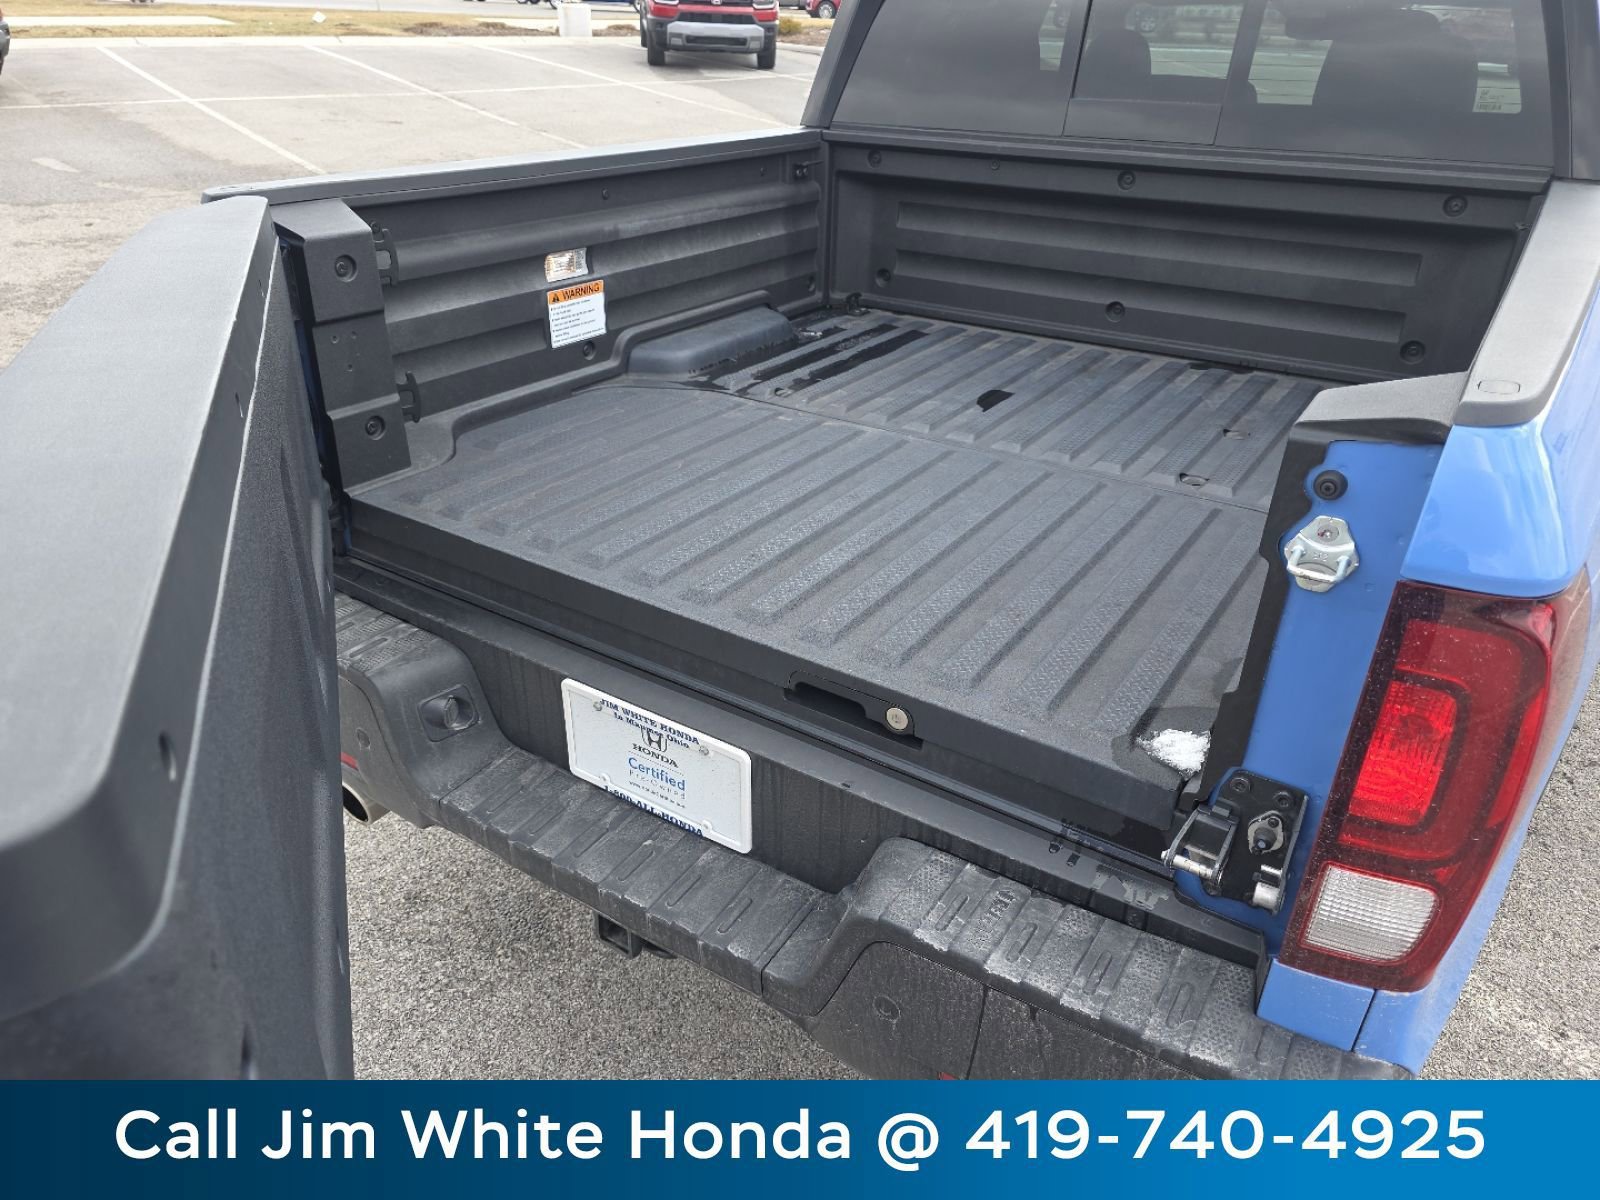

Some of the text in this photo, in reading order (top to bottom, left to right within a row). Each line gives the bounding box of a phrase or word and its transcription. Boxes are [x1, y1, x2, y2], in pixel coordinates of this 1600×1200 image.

[562, 283, 600, 300] WARNING
[600, 699, 699, 745] JIM WHITE HONDA
[667, 734, 690, 748] Ohio
[632, 743, 679, 768] HONDA
[628, 757, 686, 791] Certified
